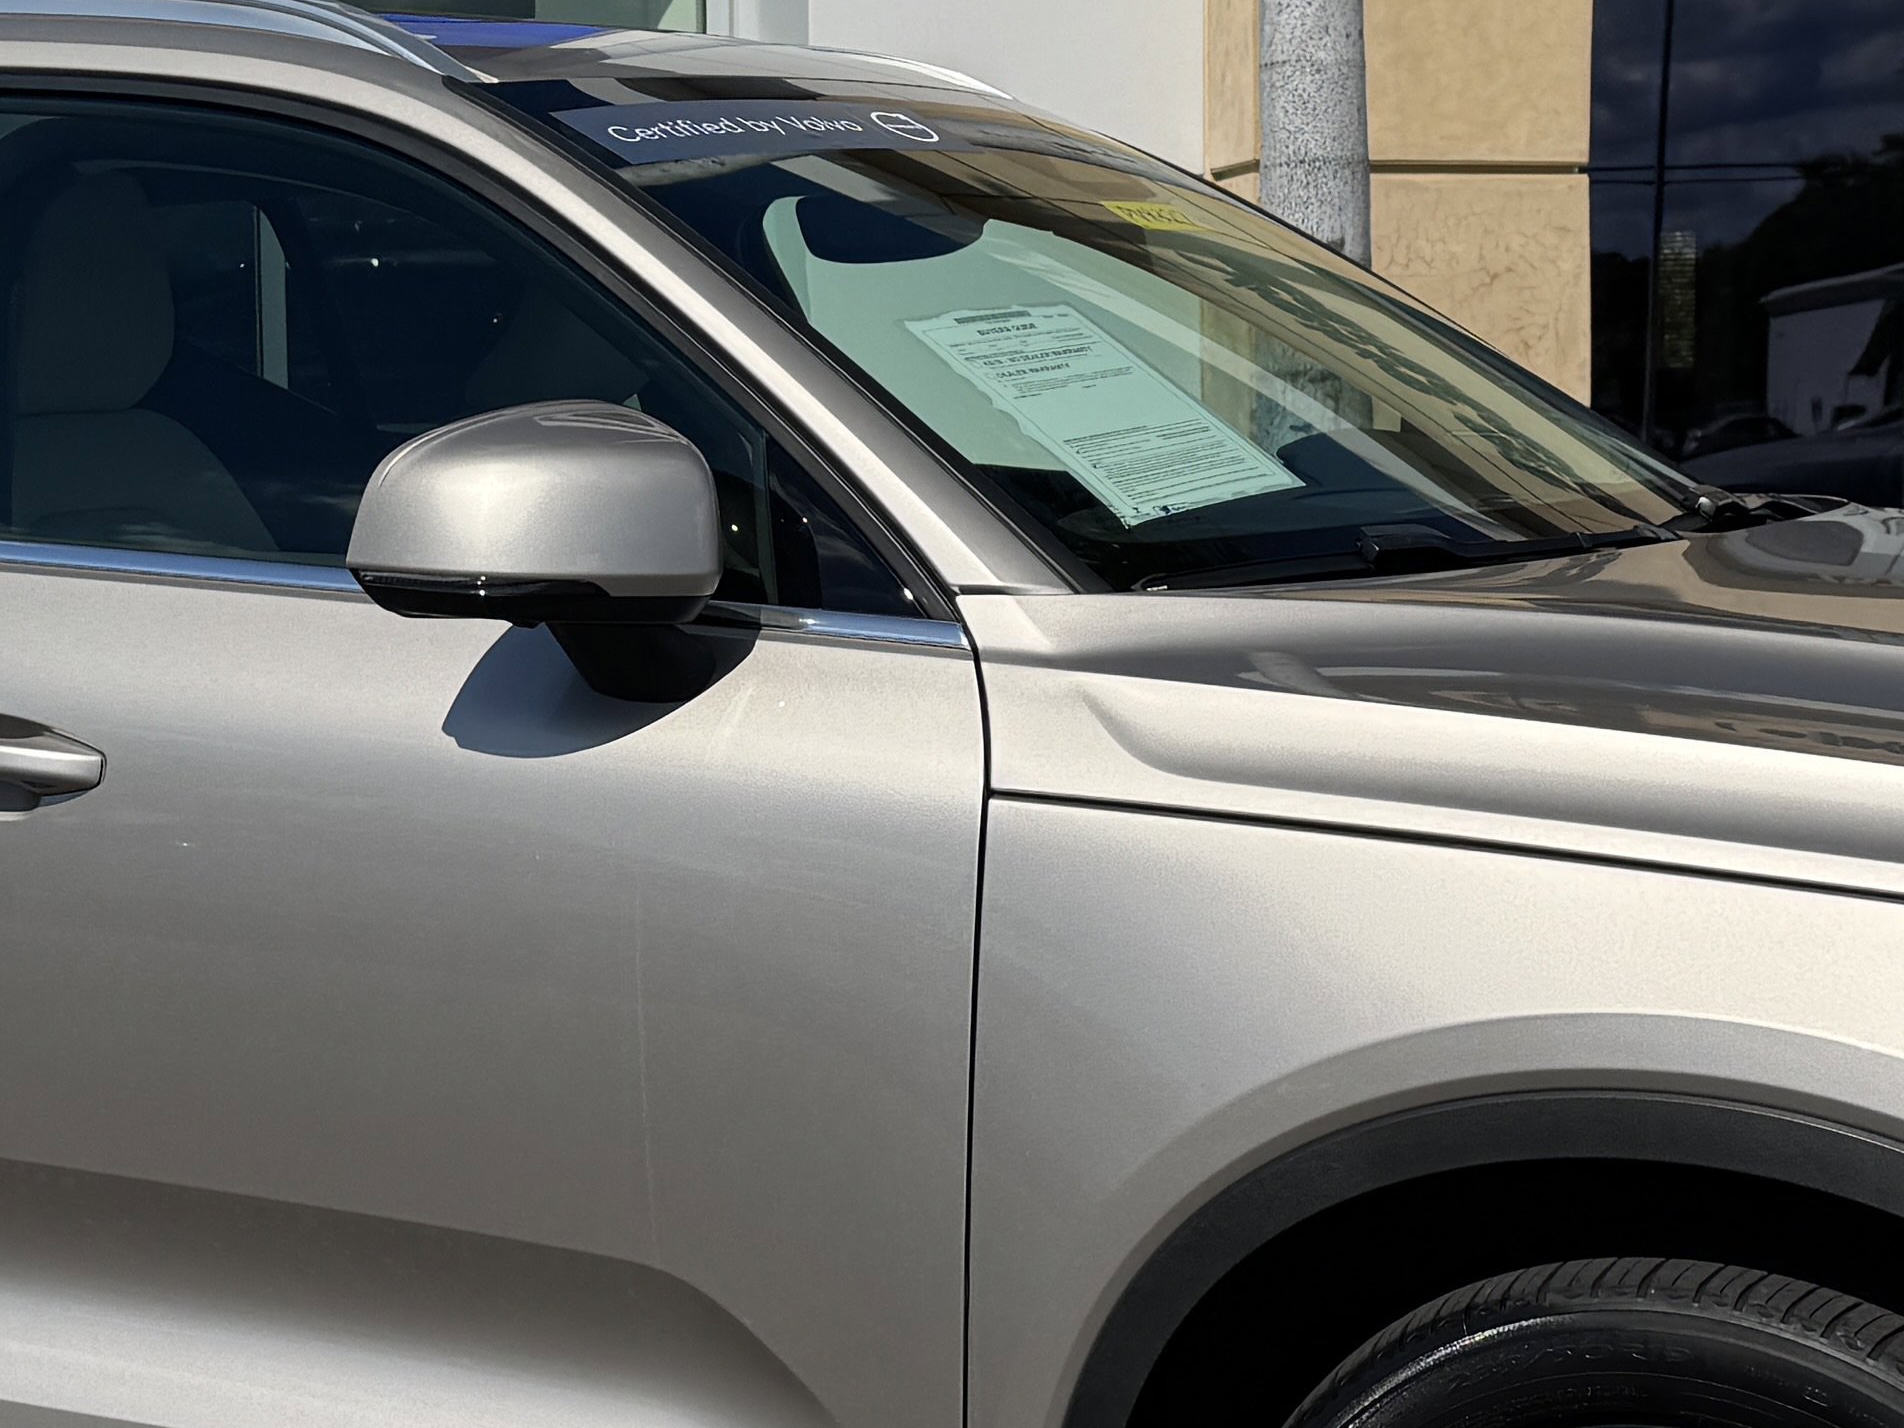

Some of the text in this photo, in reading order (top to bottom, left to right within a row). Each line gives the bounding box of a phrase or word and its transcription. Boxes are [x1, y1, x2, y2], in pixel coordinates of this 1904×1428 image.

[607, 116, 864, 143] Certified by Volvo
